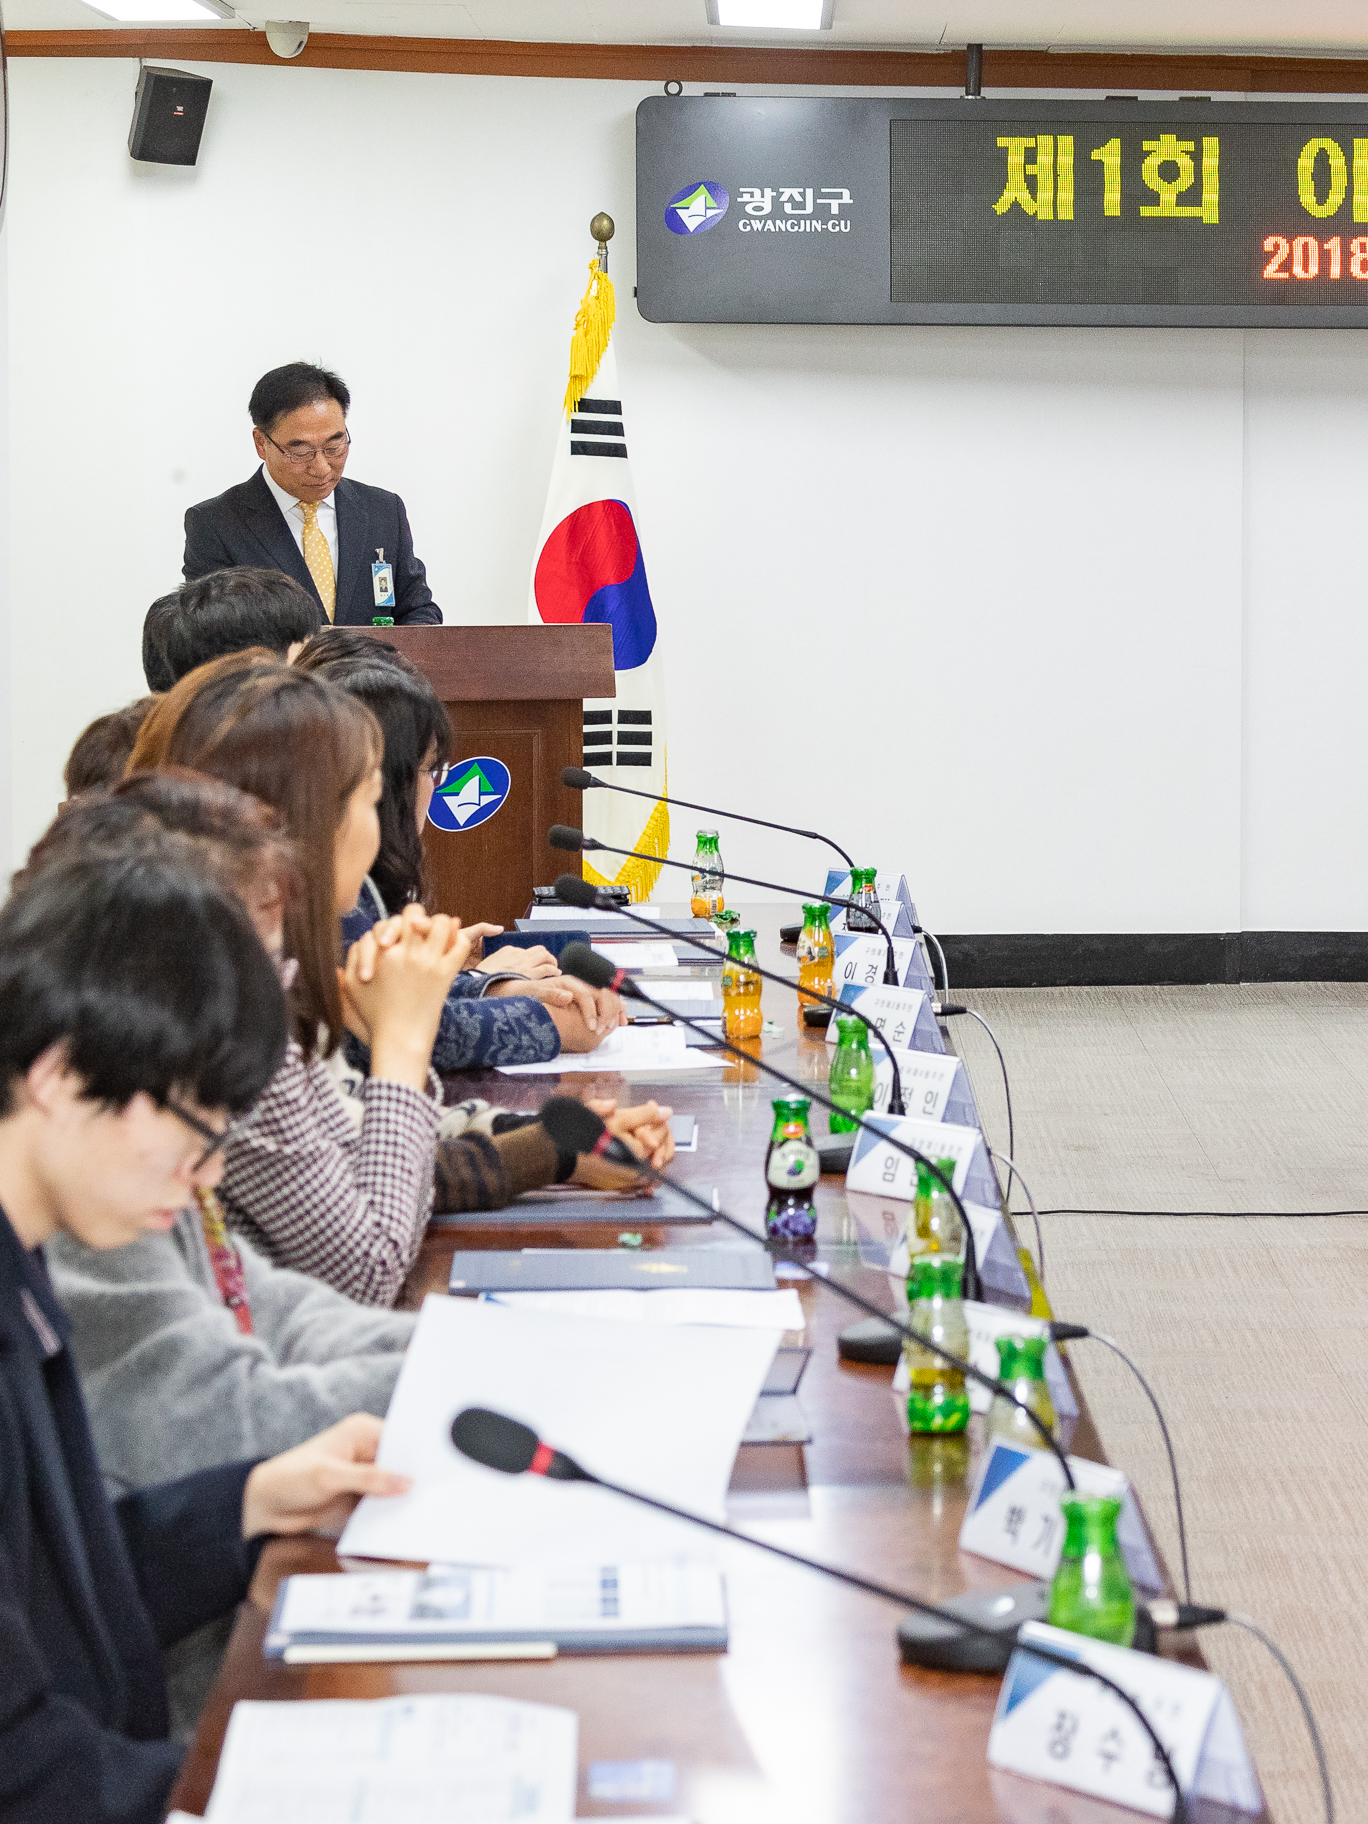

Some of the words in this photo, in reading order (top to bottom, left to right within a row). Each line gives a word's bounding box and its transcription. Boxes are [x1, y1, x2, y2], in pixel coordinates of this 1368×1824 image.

[989, 133, 1221, 225] 제1회
[736, 187, 854, 216] 광진구
[738, 219, 852, 233] GWANGJIN-GU
